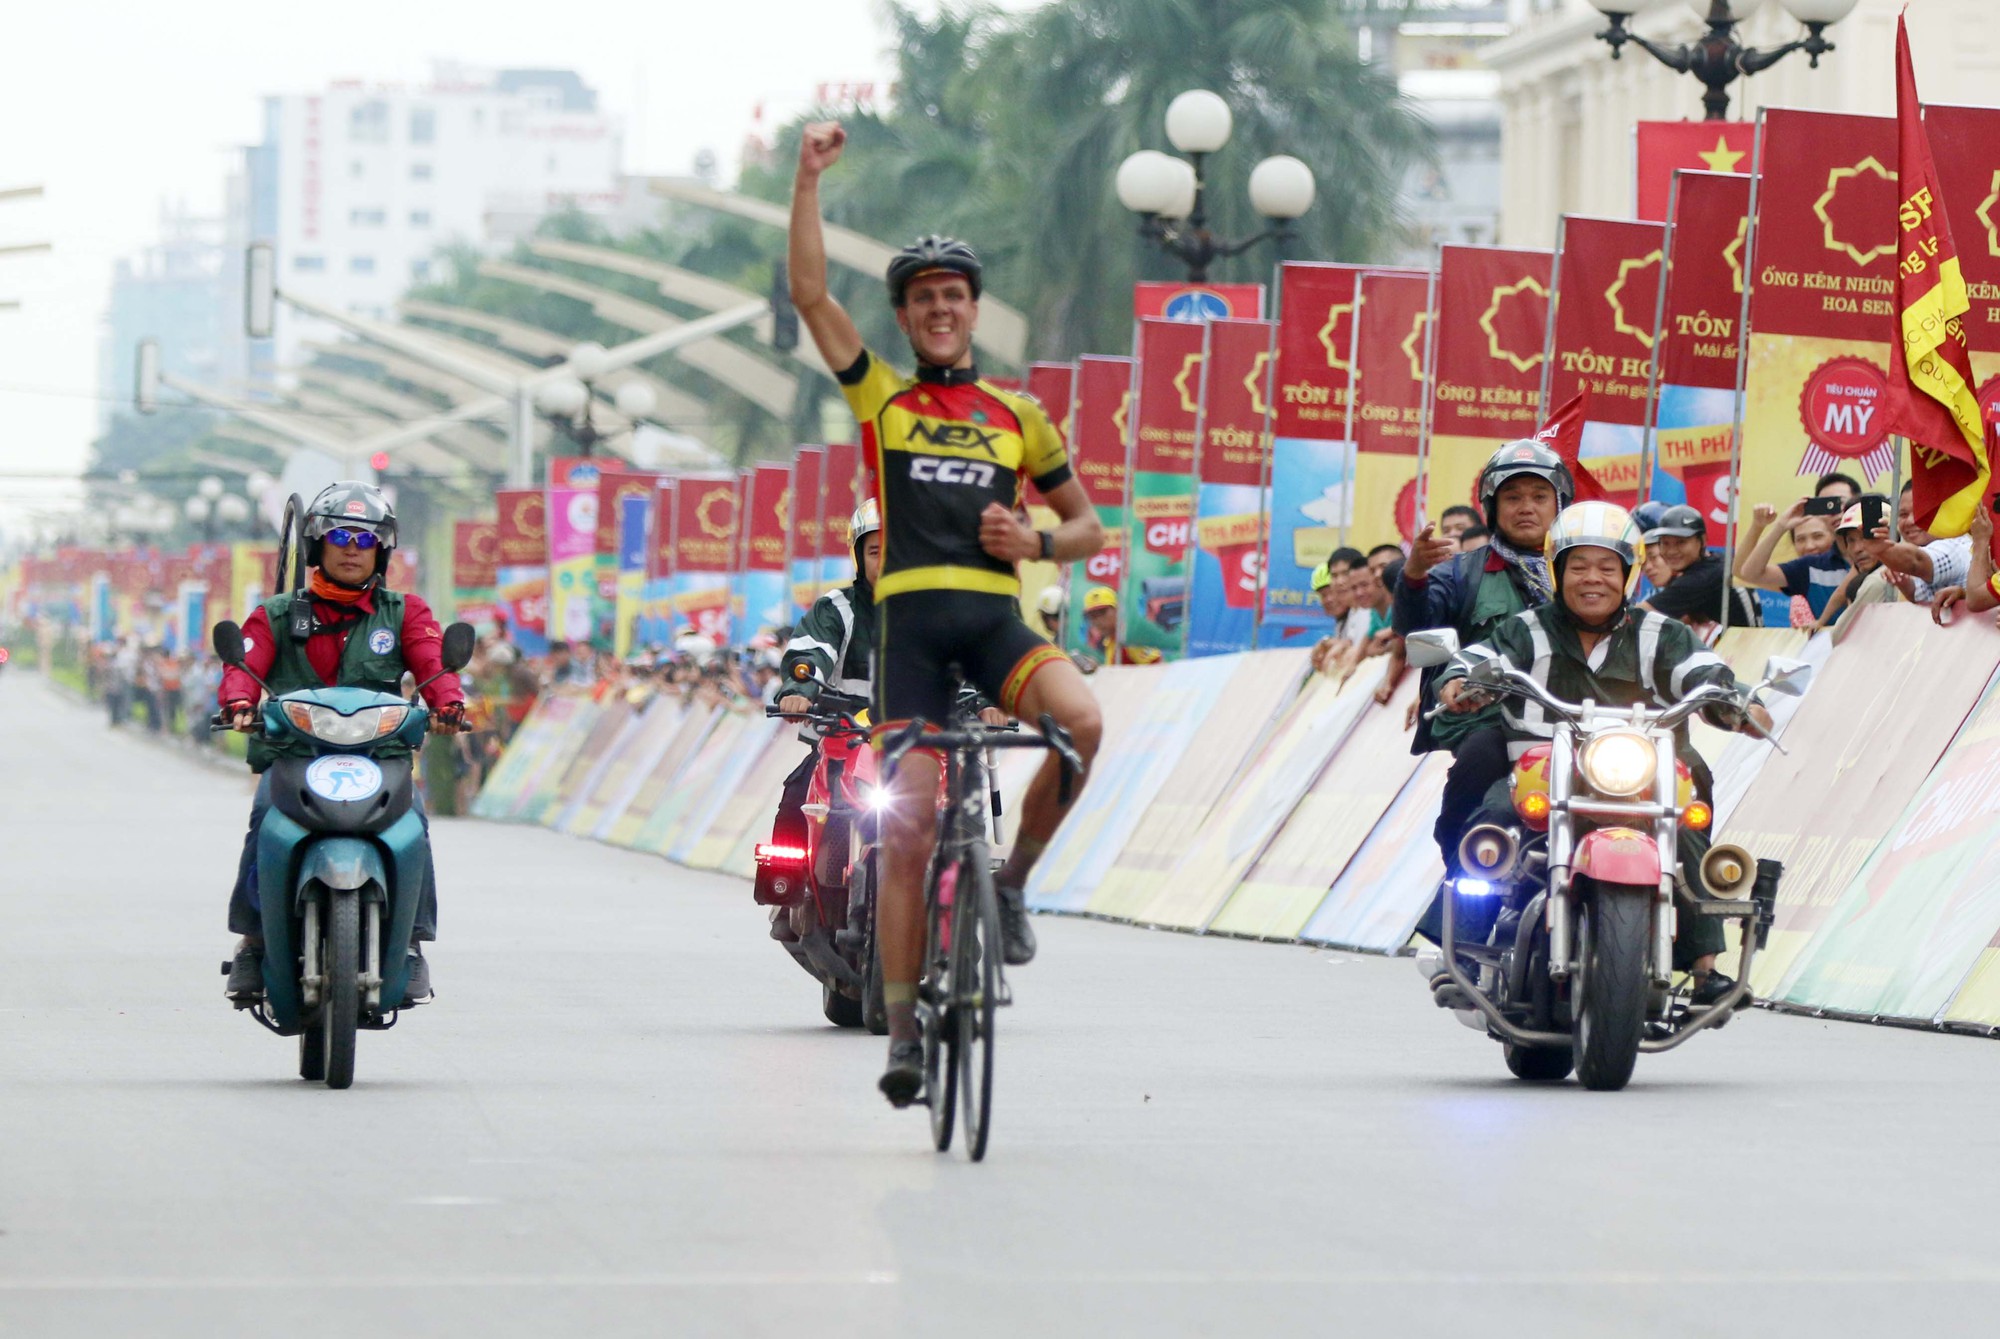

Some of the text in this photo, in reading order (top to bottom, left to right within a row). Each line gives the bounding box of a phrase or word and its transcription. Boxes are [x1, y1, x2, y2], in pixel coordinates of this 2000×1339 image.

[1761, 266, 1799, 287] ỐNG
[1822, 296, 1858, 314] HOA
[1676, 309, 1733, 338] TÔN
[1561, 347, 1615, 376] TÔN
[1282, 380, 1330, 405] TÔN
[1823, 398, 1876, 437] MỸ
